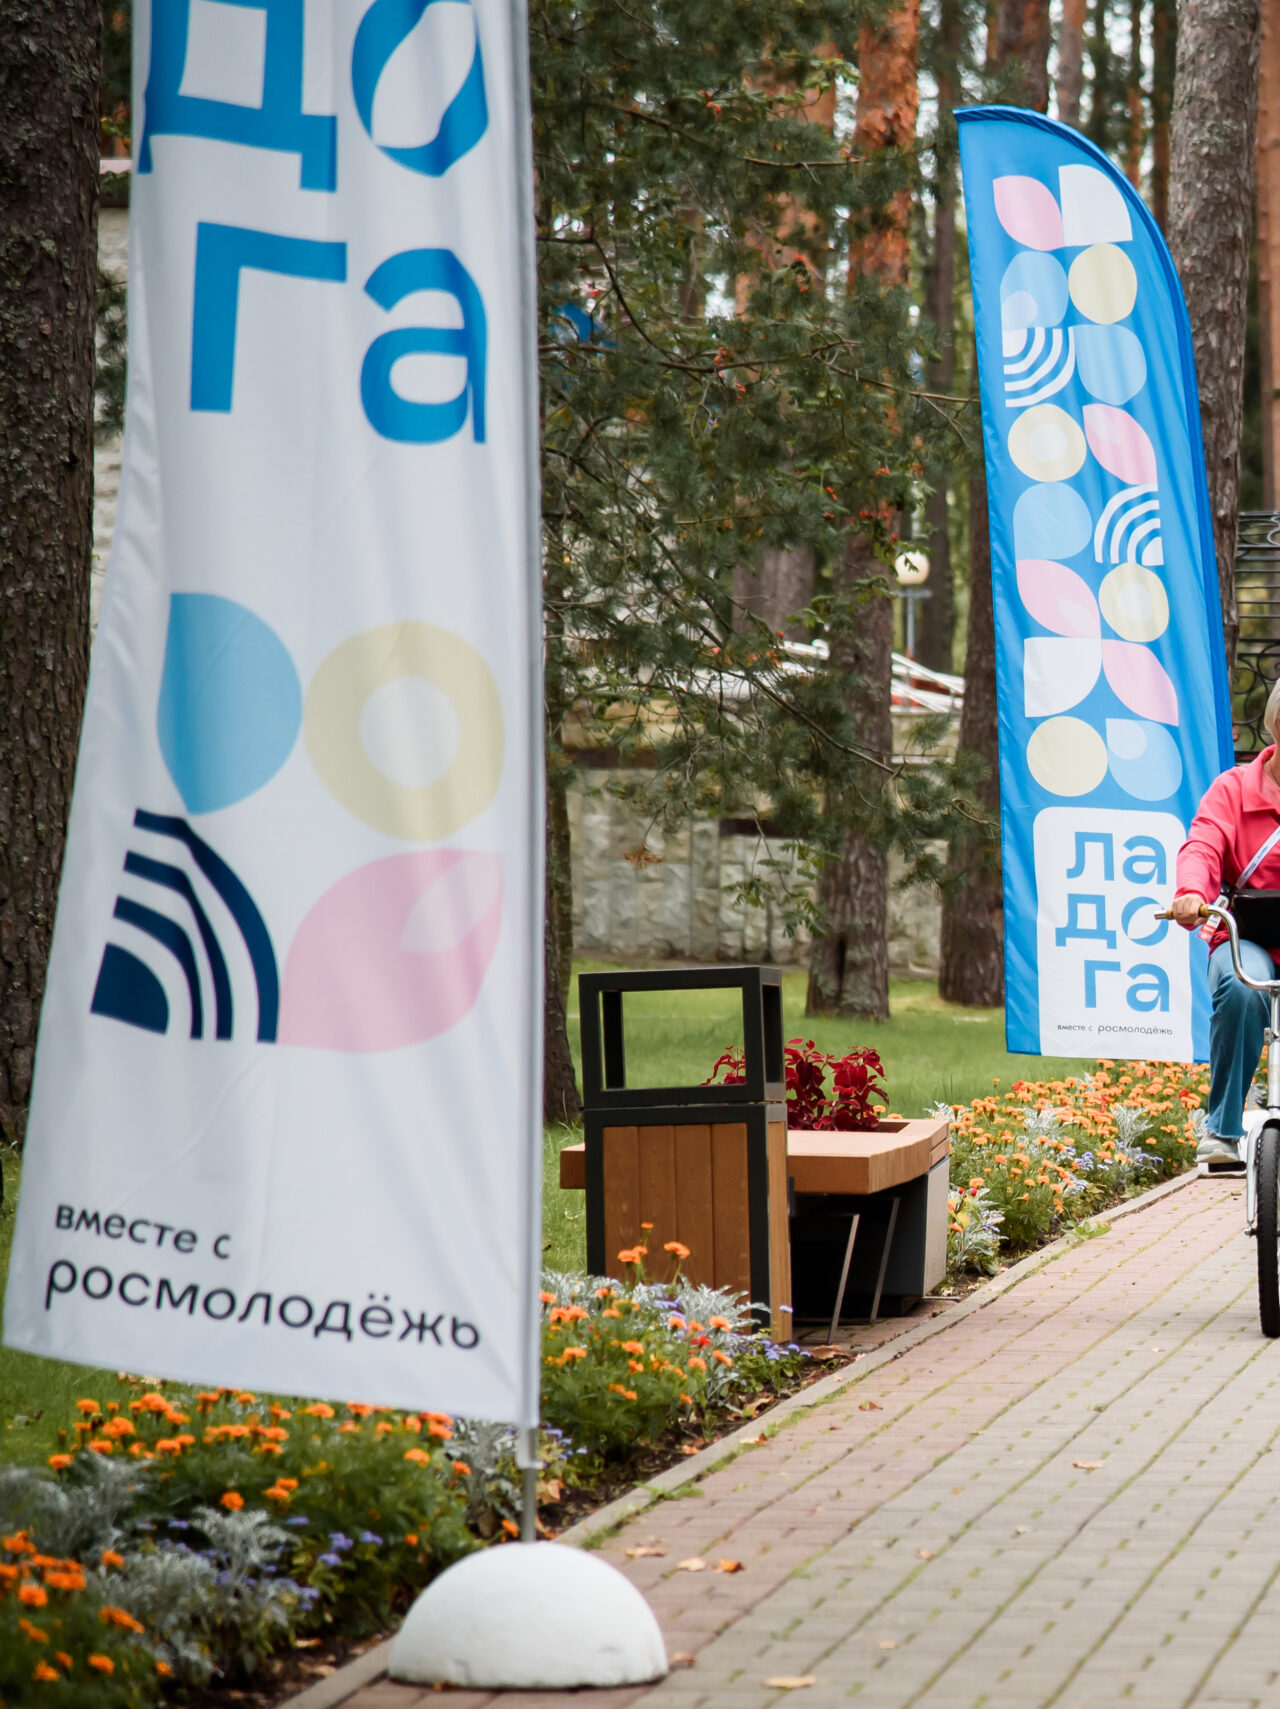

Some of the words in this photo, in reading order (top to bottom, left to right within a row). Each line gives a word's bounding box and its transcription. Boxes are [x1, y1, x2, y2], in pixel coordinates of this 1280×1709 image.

[189, 221, 488, 446] га
[1066, 831, 1167, 885] ла
[1055, 893, 1169, 949] до
[1083, 959, 1170, 1012] га
[55, 1204, 198, 1254] вместе
[213, 1234, 231, 1260] с
[45, 1259, 482, 1351] росмолодёжь
